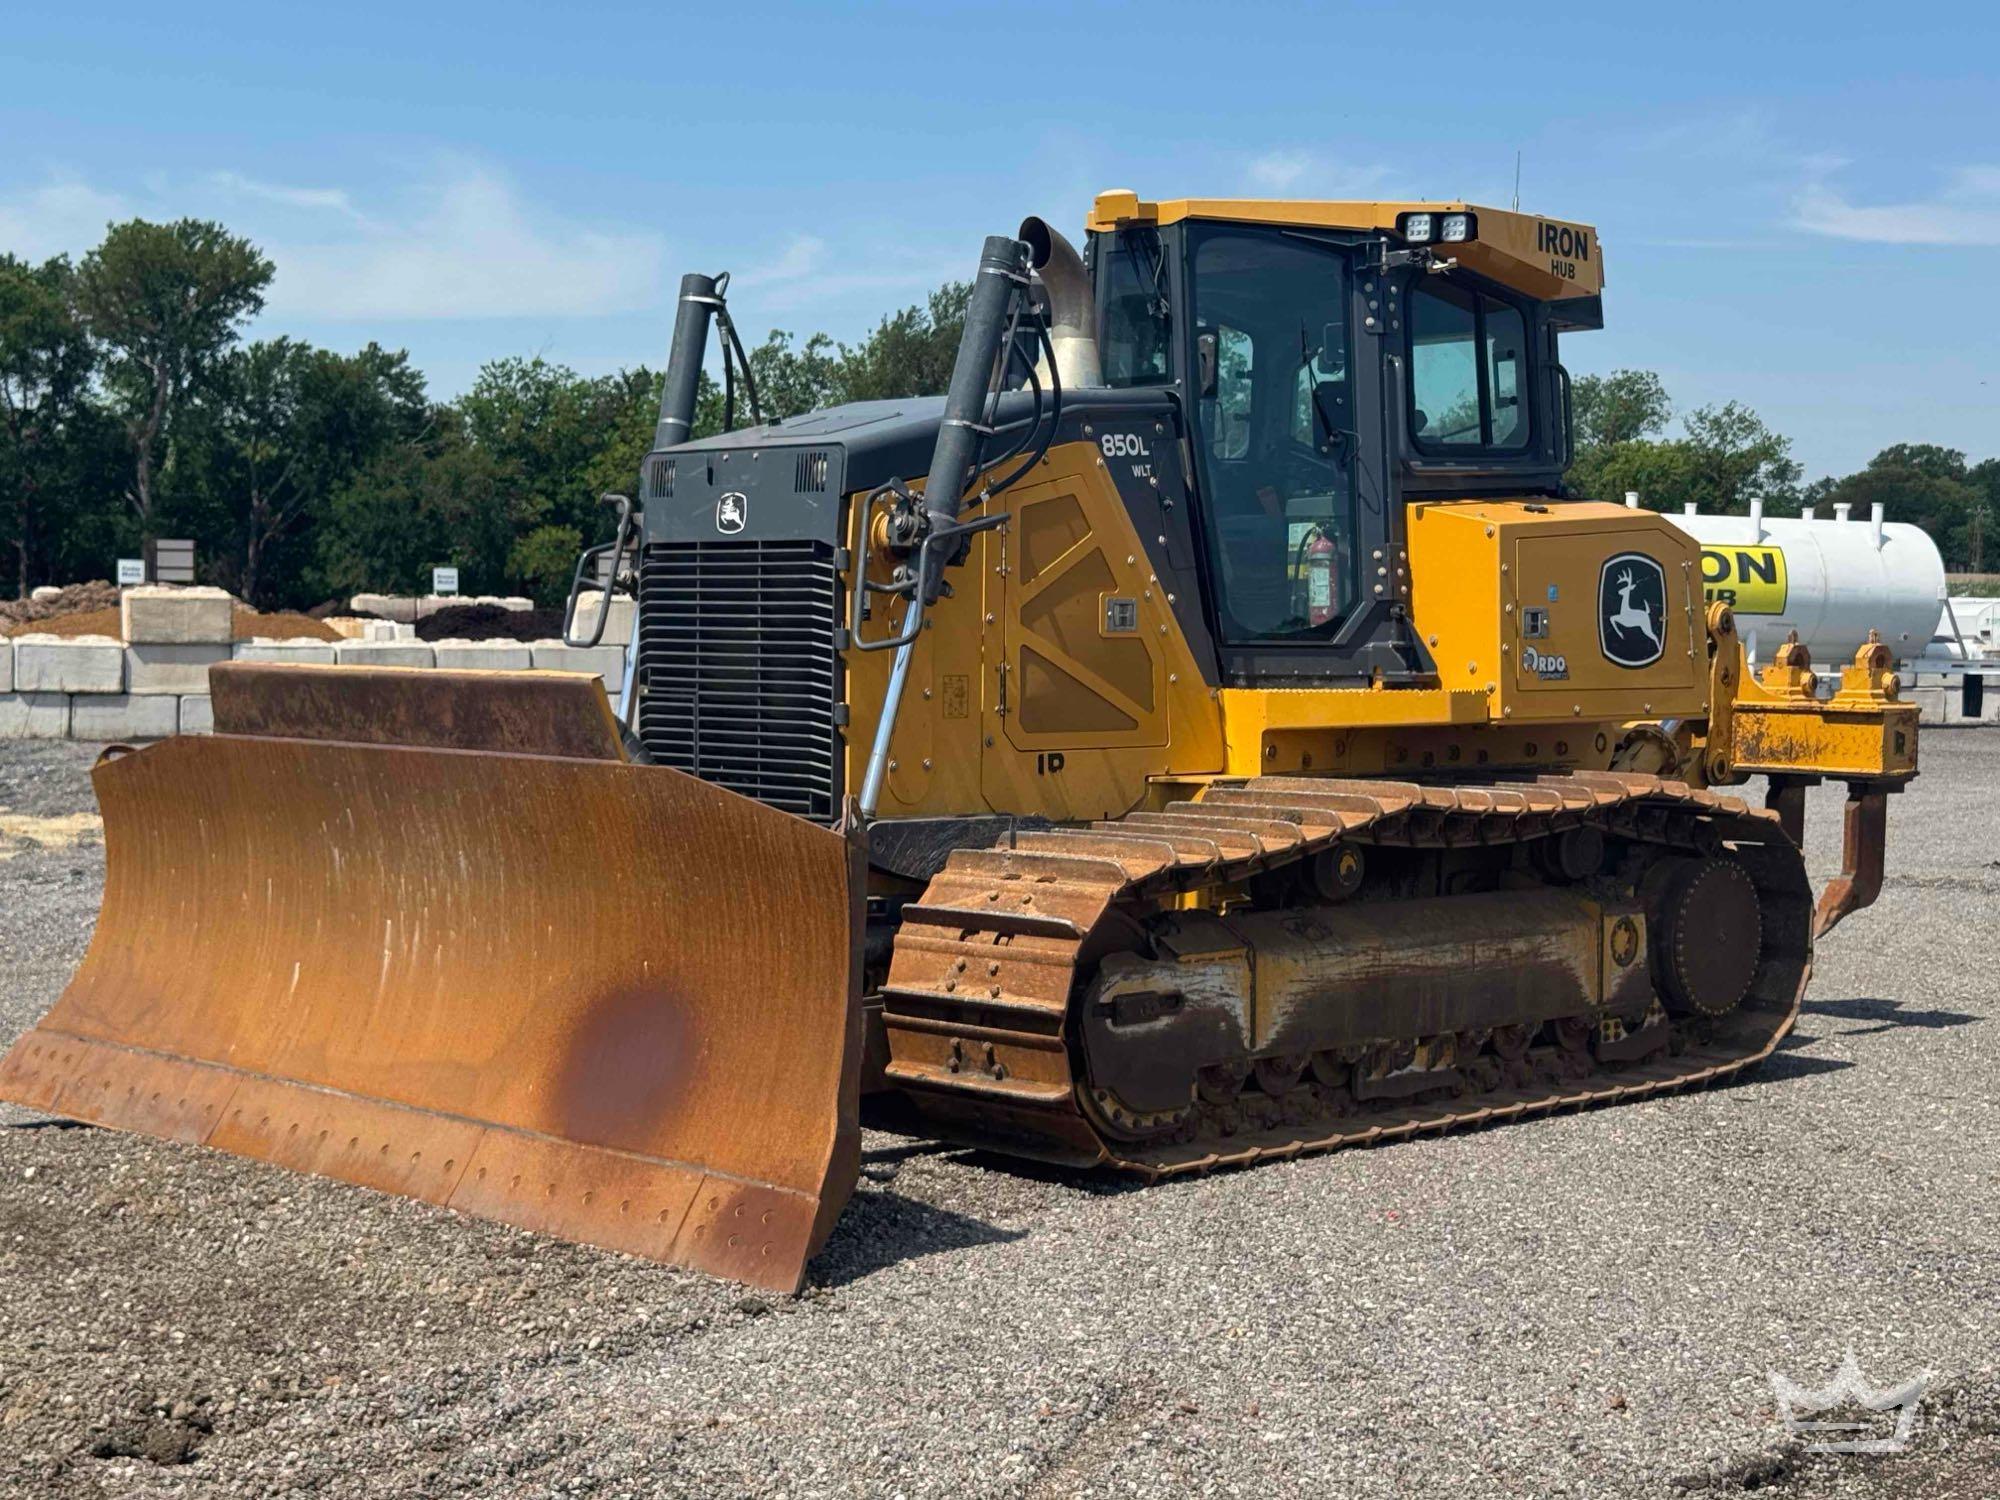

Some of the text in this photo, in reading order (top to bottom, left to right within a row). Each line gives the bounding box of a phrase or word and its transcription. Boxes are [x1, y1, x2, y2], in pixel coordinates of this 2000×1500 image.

[1537, 221, 1588, 261] IRON
[1551, 259, 1575, 279] HUB
[1101, 433, 1150, 457] 850L
[1131, 464, 1151, 478] WLT
[1700, 551, 1777, 584] ON
[1538, 656, 1566, 672] RDO
